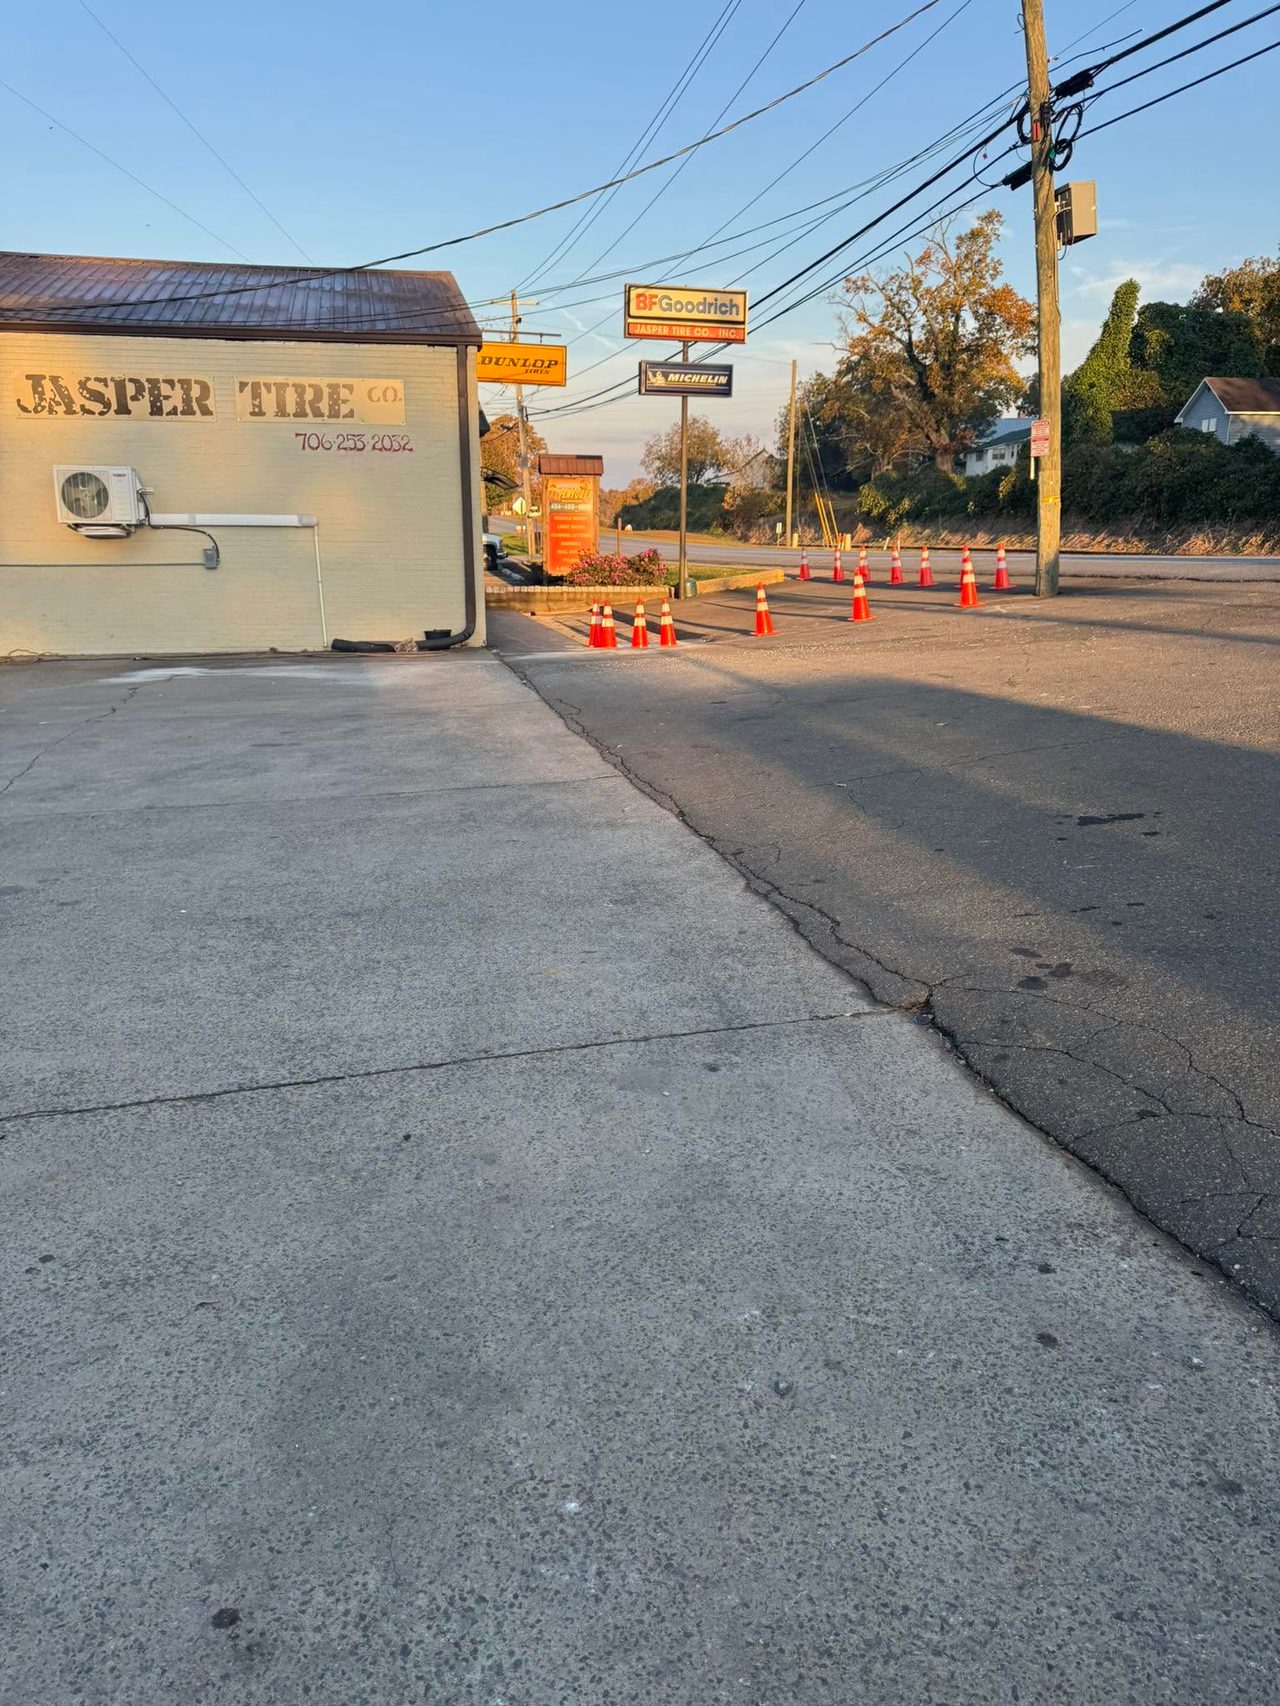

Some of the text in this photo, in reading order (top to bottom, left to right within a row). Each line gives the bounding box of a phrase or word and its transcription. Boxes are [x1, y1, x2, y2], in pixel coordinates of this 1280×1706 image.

[635, 292, 740, 316] BFGoodrich
[635, 323, 670, 336] JASPER
[671, 325, 691, 337] TIRE
[718, 328, 740, 339] INC.
[479, 355, 559, 369] DUNLOP
[667, 373, 729, 385] MICHELIN
[16, 374, 403, 419] JASPER TIRE CO.
